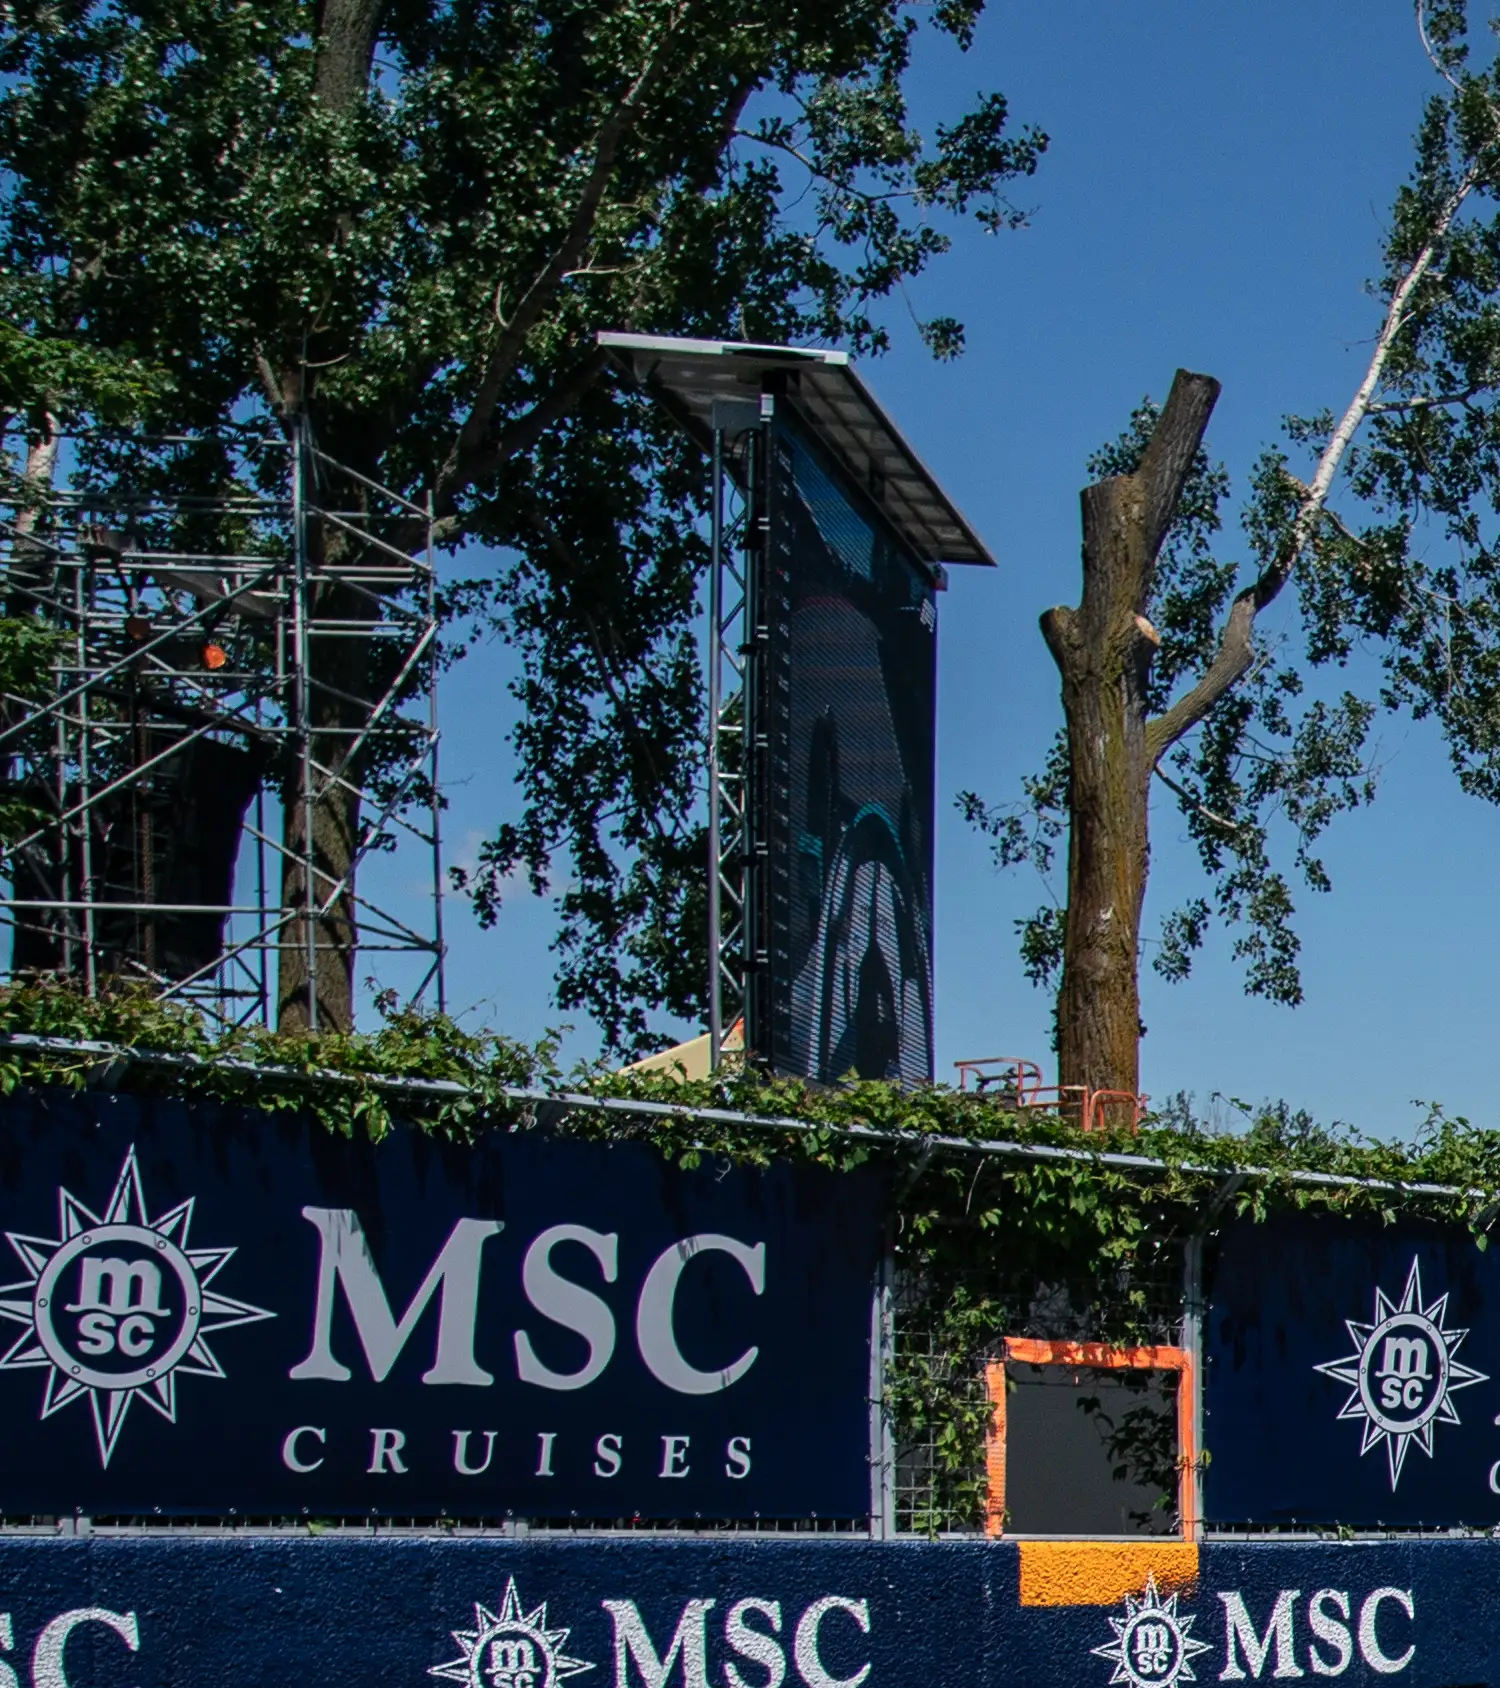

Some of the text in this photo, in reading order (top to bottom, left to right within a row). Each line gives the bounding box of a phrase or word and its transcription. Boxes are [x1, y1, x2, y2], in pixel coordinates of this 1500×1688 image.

[288, 1205, 766, 1395] MSC
[282, 1425, 751, 1480] CRUISES
[1216, 1586, 1416, 1681] MSC
